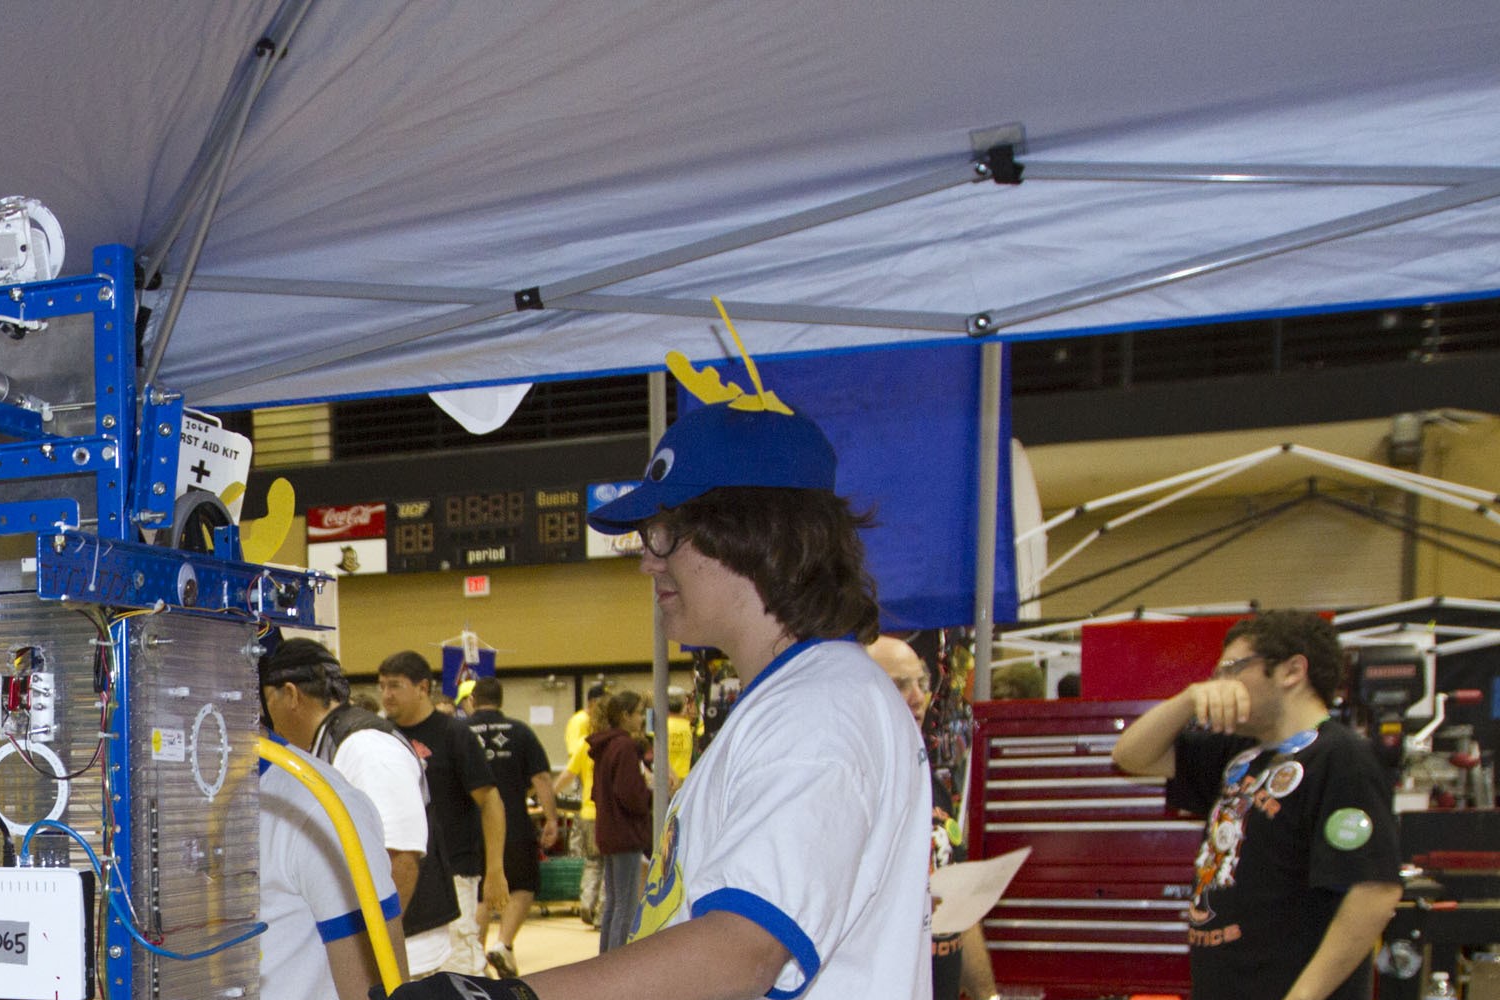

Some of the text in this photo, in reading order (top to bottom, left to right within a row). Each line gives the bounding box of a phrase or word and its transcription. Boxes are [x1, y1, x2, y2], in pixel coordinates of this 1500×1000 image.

[180, 432, 240, 460] RST AID KIT
[536, 490, 579, 506] Guests
[398, 502, 431, 518] UCF
[466, 546, 506, 564] period
